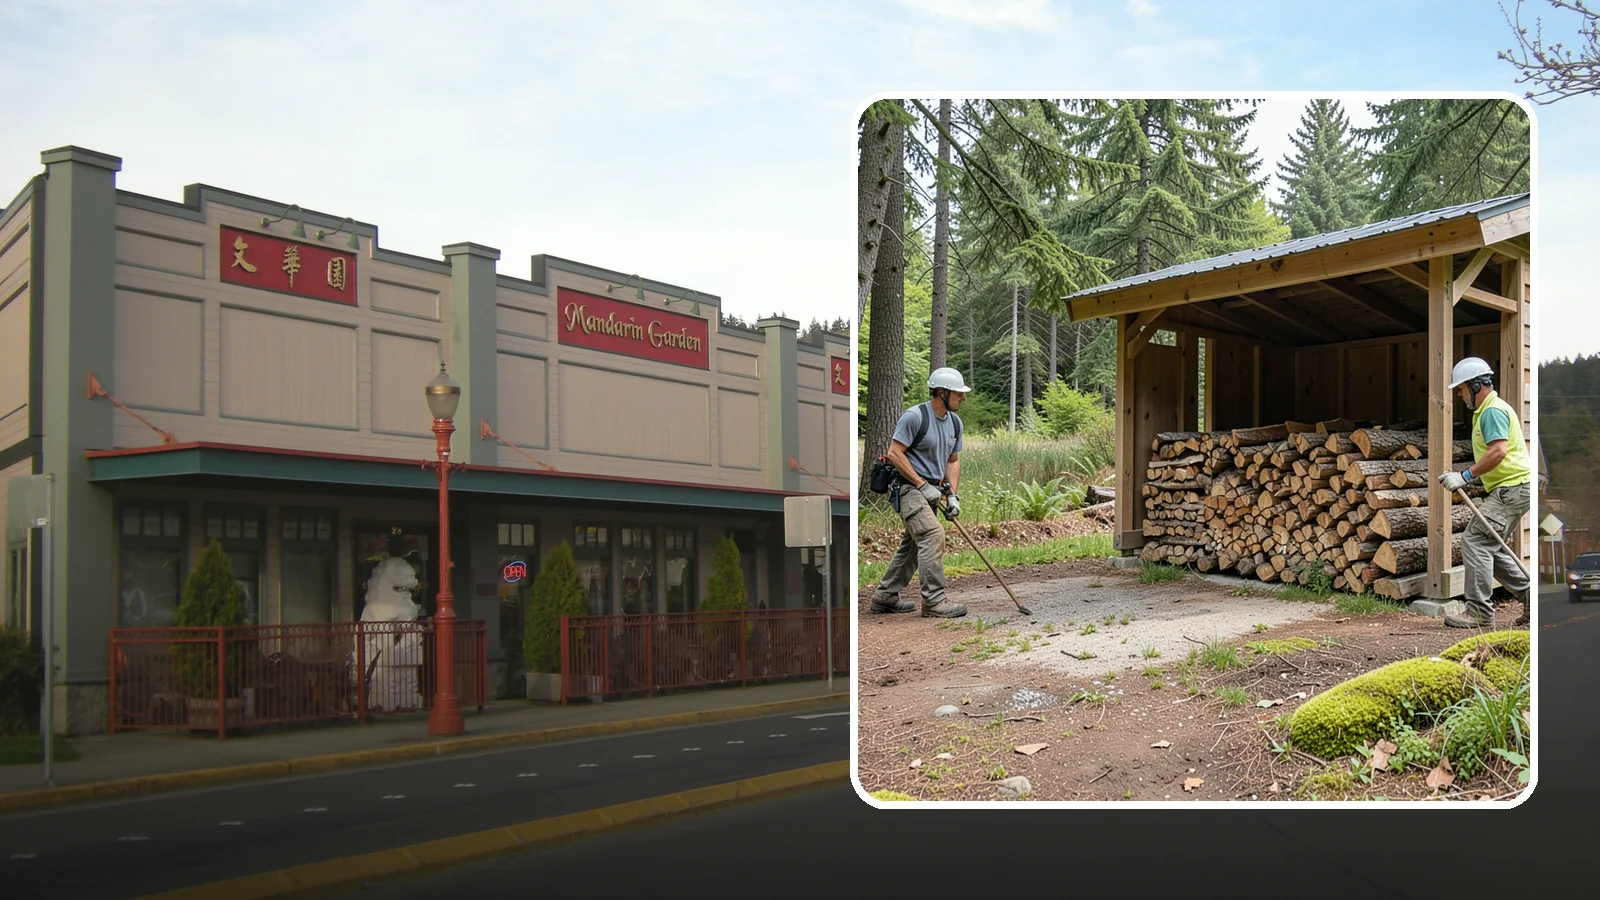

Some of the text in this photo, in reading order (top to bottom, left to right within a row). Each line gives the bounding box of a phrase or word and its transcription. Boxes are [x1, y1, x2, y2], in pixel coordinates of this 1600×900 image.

[231, 236, 346, 291] 文華園
[564, 302, 701, 352] Mandarin Garden
[835, 363, 846, 386] 文
[503, 565, 526, 578] OPEN
